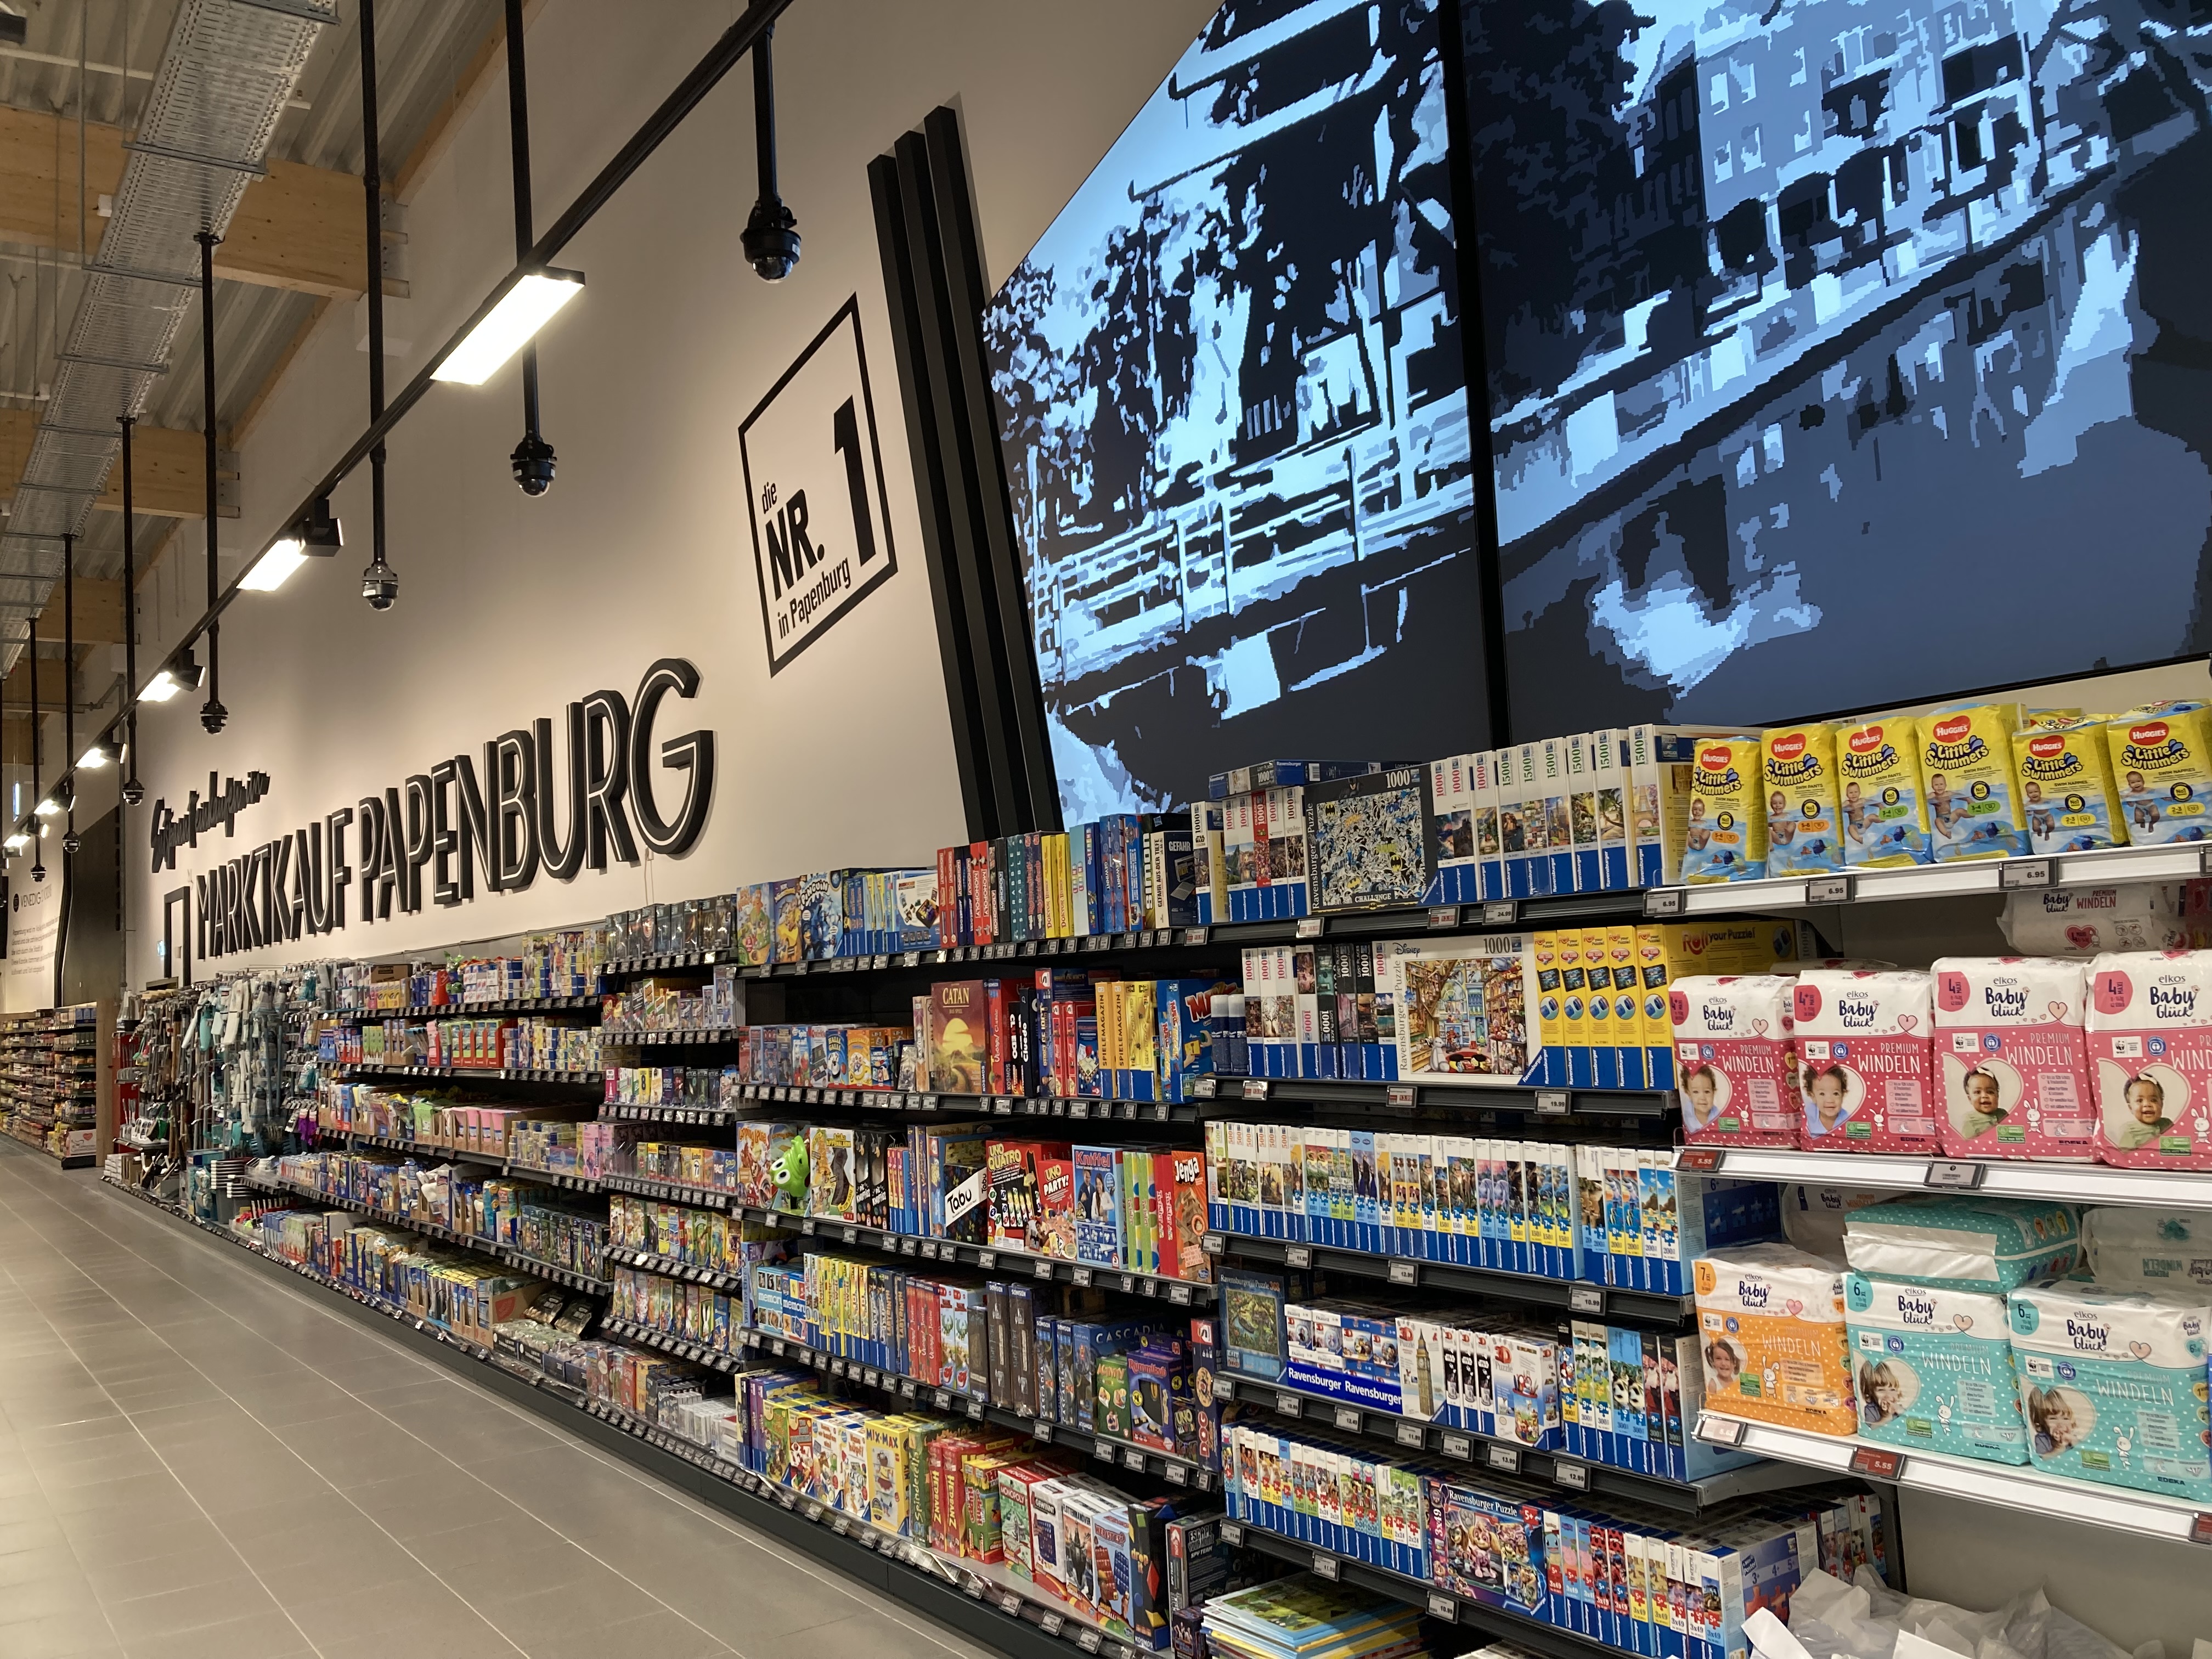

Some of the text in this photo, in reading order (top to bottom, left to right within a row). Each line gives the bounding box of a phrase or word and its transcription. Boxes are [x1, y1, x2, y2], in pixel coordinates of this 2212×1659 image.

[761, 482, 777, 515] die
[765, 394, 876, 602] NR. 1
[777, 557, 851, 639] in Papenburg
[1937, 725, 1967, 736] HUGGIES
[2132, 730, 2166, 740] HUGGIES
[1774, 743, 1803, 752] HUGGIES
[1852, 735, 1880, 747] HUGGIES
[2033, 743, 2062, 752] HUGGIES
[1703, 753, 1728, 763] HUGGIES
[1938, 743, 1970, 758] Little
[2135, 747, 2170, 760] Little
[1547, 753, 1556, 778] 1500
[1573, 749, 1582, 775] 1500
[1775, 761, 1804, 774] Little
[1853, 754, 1883, 767] Little
[2034, 759, 2066, 771] Little
[1386, 769, 1410, 788] 1000
[1503, 762, 1511, 786] 1500
[1524, 758, 1533, 783] 1500
[1700, 772, 1727, 785] Little
[1435, 774, 1443, 797] 1000
[1453, 770, 1461, 793] 1000
[196, 808, 352, 960] MARKTKAUF
[359, 658, 714, 922] PAPENBURG
[1169, 841, 1191, 853] GEFAHR
[1312, 844, 1320, 909] Ravensburger
[20, 892, 41, 908] VENEDIG
[1354, 893, 1392, 904] CHALLENGE
[2043, 893, 2070, 907] Baby
[2076, 896, 2117, 909] WINDELN
[1683, 928, 1756, 955] Roll your Puzzle!
[2159, 975, 2186, 983] elkos
[943, 988, 969, 1006] CATAN
[1985, 988, 2028, 1009] Baby
[2151, 987, 2195, 1011] Baby
[1703, 1005, 1734, 1024] Baby
[1839, 1001, 1876, 1020] Baby
[1991, 1006, 2024, 1017] Glück
[2157, 1006, 2193, 1018] Glück
[1708, 1019, 1733, 1030] Glück
[1843, 1016, 1872, 1027] Glück
[1400, 1005, 1408, 1071] Ravensburger
[2030, 1032, 2070, 1044] PREMIUM
[1740, 1045, 1771, 1055] PREMIUM
[1881, 1043, 1919, 1054] PREMIUM
[2005, 1046, 2073, 1066] WINDELN
[1722, 1056, 1774, 1073] WINDELN
[1858, 1054, 1920, 1073] WINDELN
[988, 1143, 1005, 1158] UNO
[988, 1149, 1022, 1172] QUATRO
[1075, 1151, 1111, 1167] Kniffel
[1045, 1165, 1062, 1180] UNO
[1174, 1157, 1200, 1184] Jenga
[1044, 1175, 1070, 1196] PARTY!
[947, 1186, 973, 1211] Tabu
[1221, 1274, 1250, 1286] Ravensburger
[1255, 1279, 1269, 1289] Puzzle
[758, 1292, 782, 1306] memory
[1739, 1281, 1768, 1303] Baby
[783, 1299, 806, 1313] memory
[1742, 1296, 1766, 1307] Glück
[1898, 1296, 1934, 1318] Baby
[1903, 1314, 1932, 1325] Glück
[2074, 1311, 2097, 1319] elkos
[2067, 1319, 2108, 1345] Baby
[1762, 1334, 1821, 1357] WINDELN
[1922, 1351, 1991, 1376] WINDELN
[1289, 1368, 1402, 1406] Ravensburger Ravensburger
[2096, 1379, 2174, 1407] WINDELN
[1175, 1409, 1192, 1424] UNO
[1875, 1460, 1892, 1470] 5.55
[2158, 1476, 2186, 1486] EDEKA
[932, 1470, 941, 1525] HEDBANZ
[947, 1474, 956, 1530] HEDBANZ
[1000, 1485, 1026, 1505] MONOPOLY
[1449, 1489, 1517, 1517] Ravensburger Puzzle
[1035, 1498, 1055, 1514] GEWINNT
[1188, 1525, 1214, 1542] ESCAPE
[1132, 1550, 1149, 1564] drop
